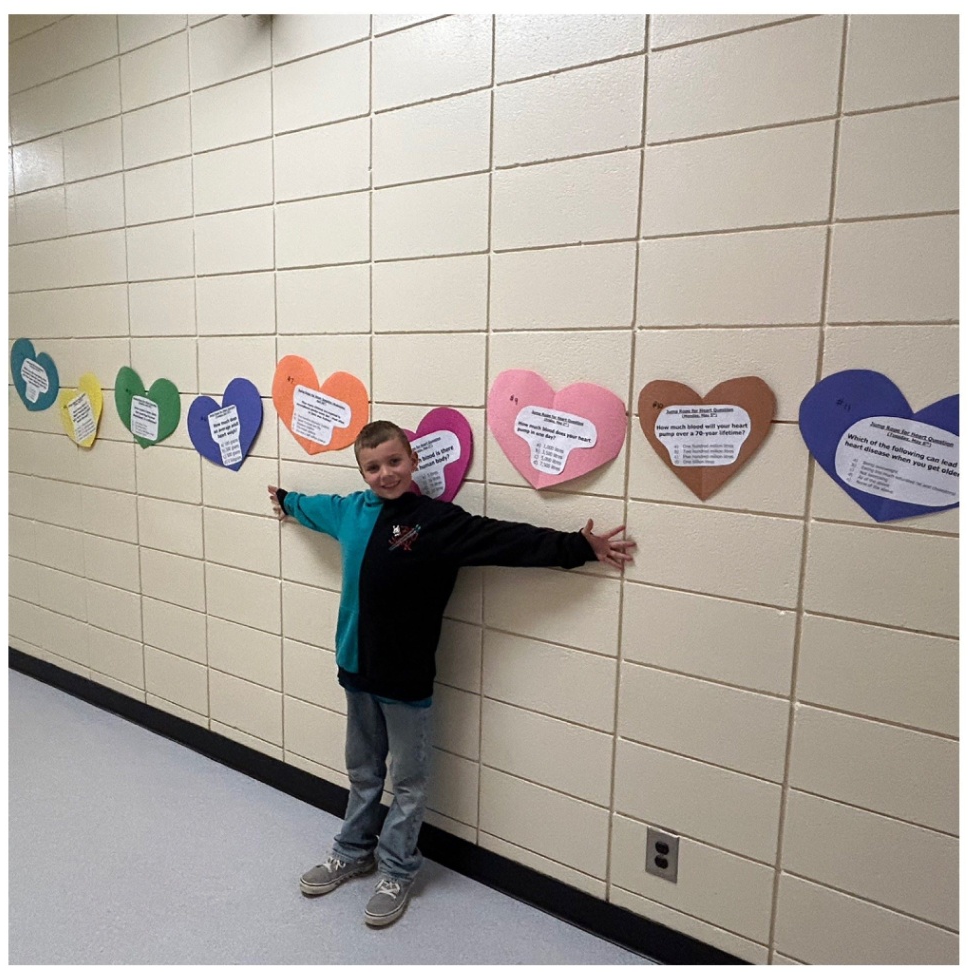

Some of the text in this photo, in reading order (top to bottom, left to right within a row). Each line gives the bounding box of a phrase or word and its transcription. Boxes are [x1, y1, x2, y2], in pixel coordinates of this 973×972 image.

[844, 440, 863, 450] heart
[864, 446, 890, 458] disease
[892, 454, 911, 464] when
[912, 460, 926, 468] you
[848, 432, 868, 444] Which
[878, 442, 890, 450] the
[892, 445, 925, 460] following
[941, 458, 958, 468] lead
